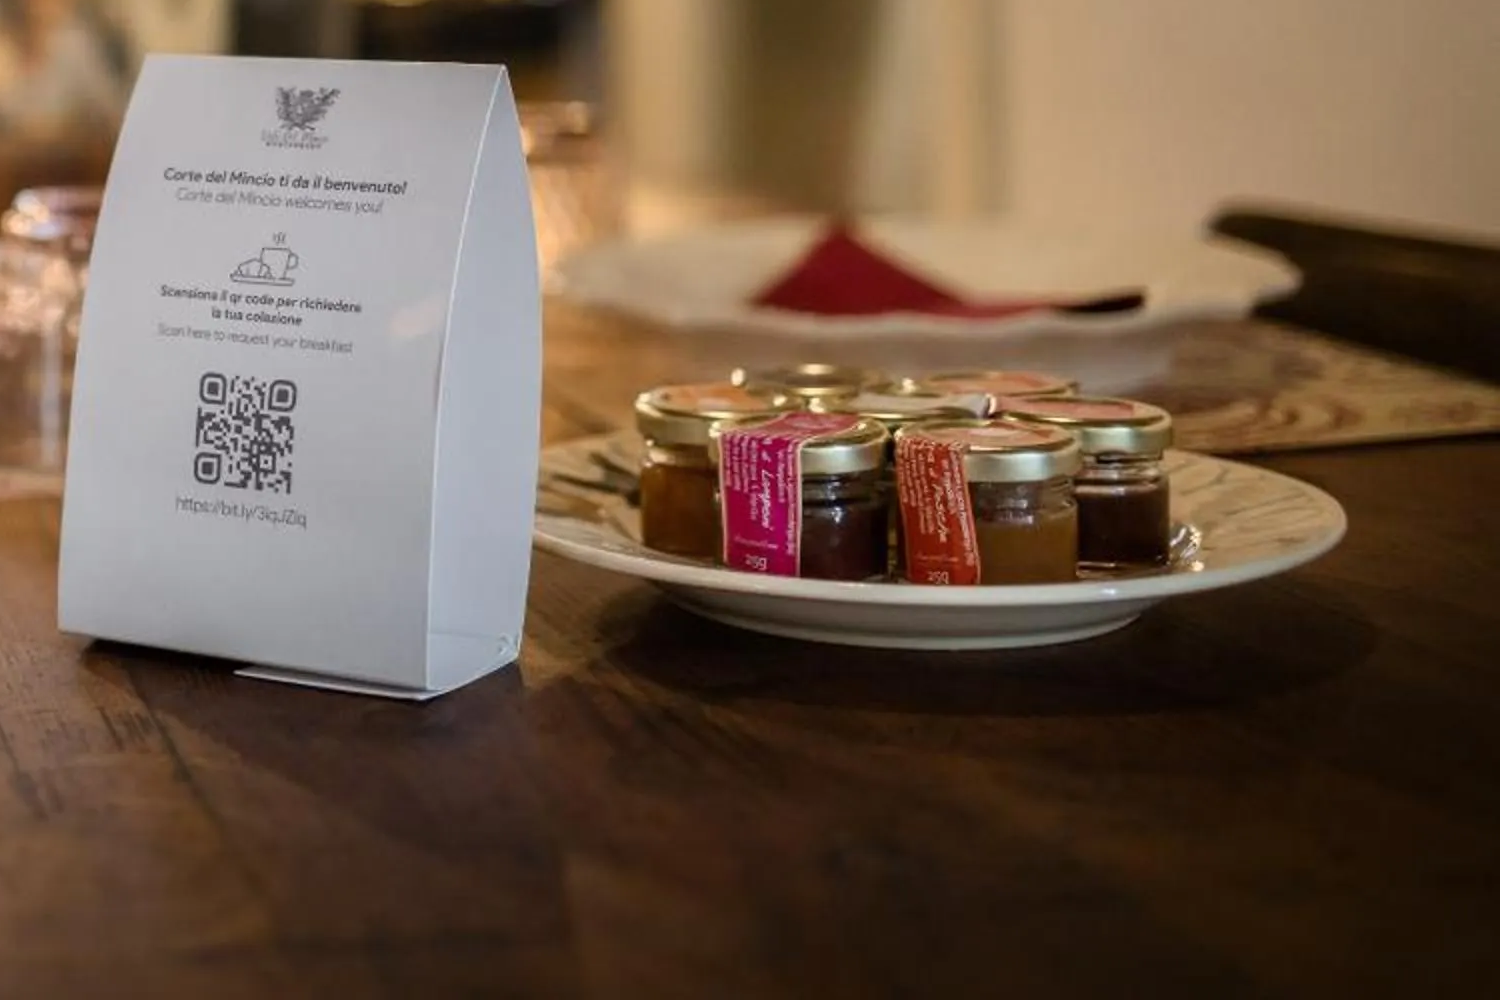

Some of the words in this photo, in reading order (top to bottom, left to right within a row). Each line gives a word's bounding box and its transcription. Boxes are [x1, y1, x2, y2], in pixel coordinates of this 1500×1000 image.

[163, 166, 203, 182] Corte
[205, 170, 227, 184] del
[229, 171, 276, 187] Mincio
[279, 175, 290, 187] ti
[291, 175, 310, 189] da
[312, 175, 322, 189] il
[323, 177, 408, 195] benvenuto!
[175, 186, 213, 203] Corte
[215, 190, 236, 205] del
[239, 190, 282, 207] Mincio
[285, 198, 353, 212] welcomes
[229, 293, 242, 304] qr
[245, 294, 275, 306] code
[275, 298, 298, 309] per
[299, 297, 362, 313] richiedere
[224, 309, 243, 321] tua
[245, 311, 303, 326] colazione
